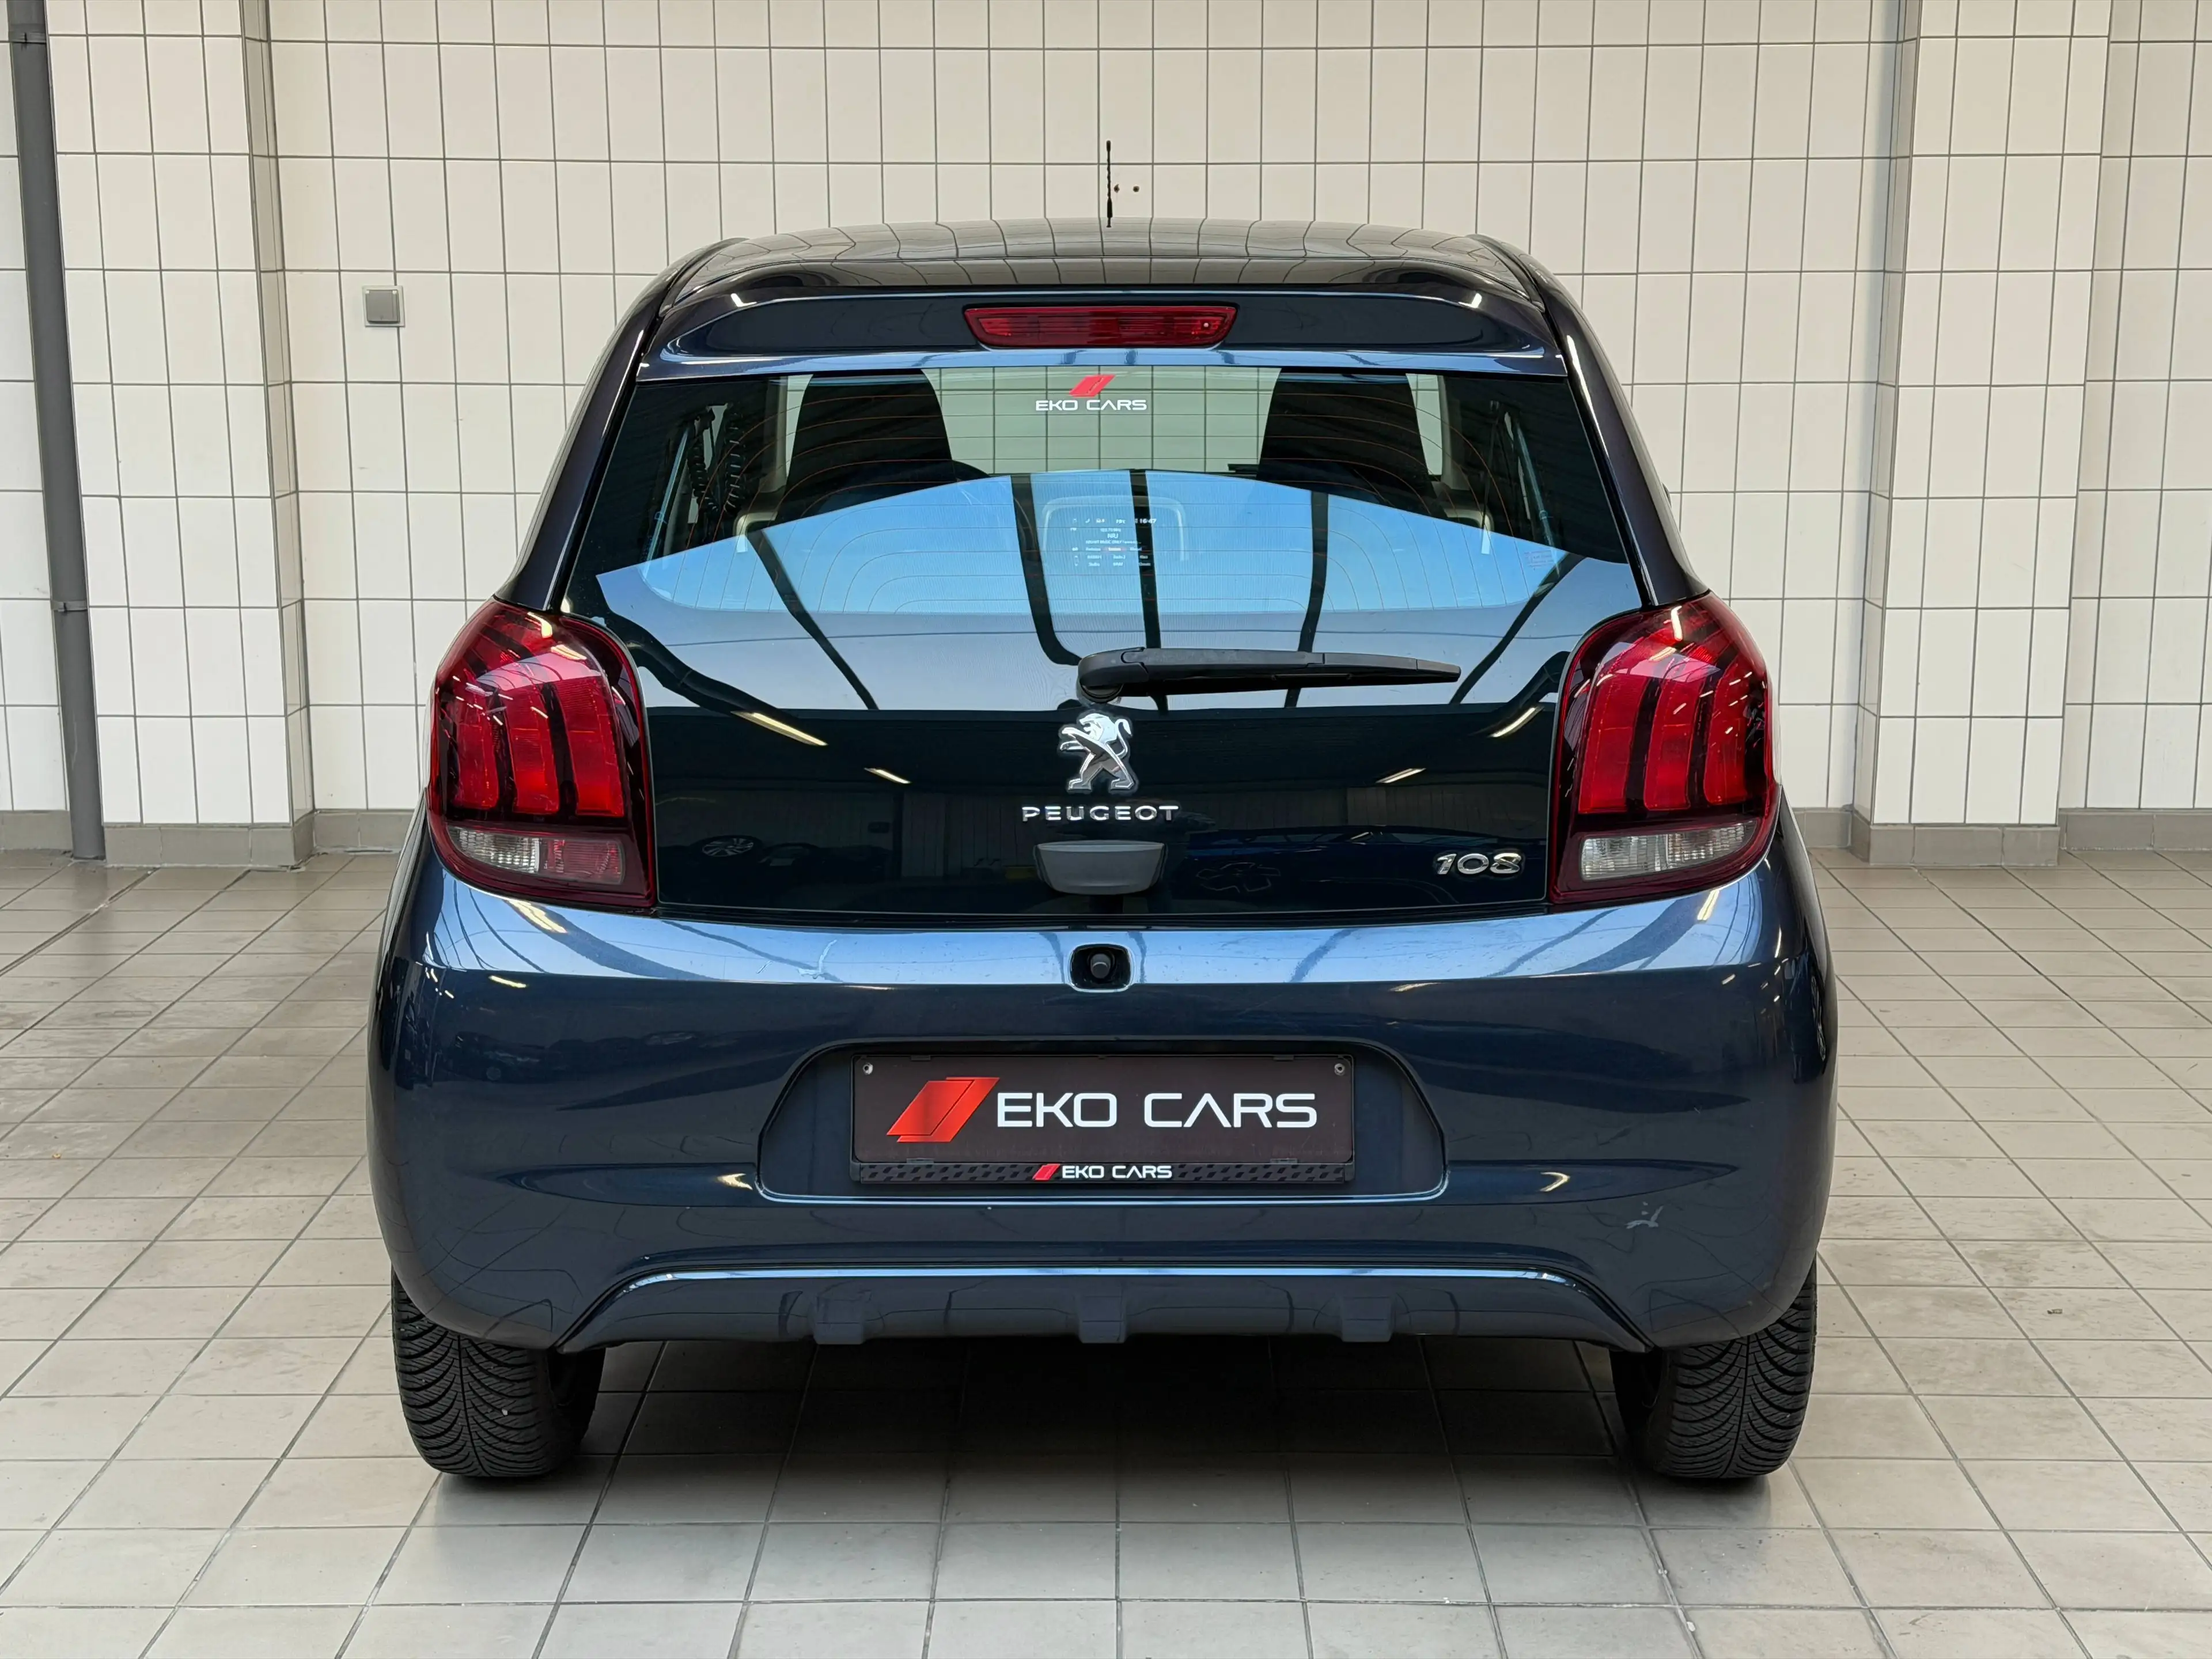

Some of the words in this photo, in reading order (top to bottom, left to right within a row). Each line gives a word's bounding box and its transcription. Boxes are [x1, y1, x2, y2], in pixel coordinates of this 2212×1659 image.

[1036, 400, 1078, 411] EKO
[1086, 399, 1147, 411] CARS
[1022, 805, 1179, 822] PEUGEOT
[1437, 852, 1522, 875] 108
[997, 1092, 1117, 1127] EKO
[1144, 1093, 1317, 1128] CARS
[1062, 1165, 1104, 1179] EKO
[1112, 1165, 1172, 1179] CARS
